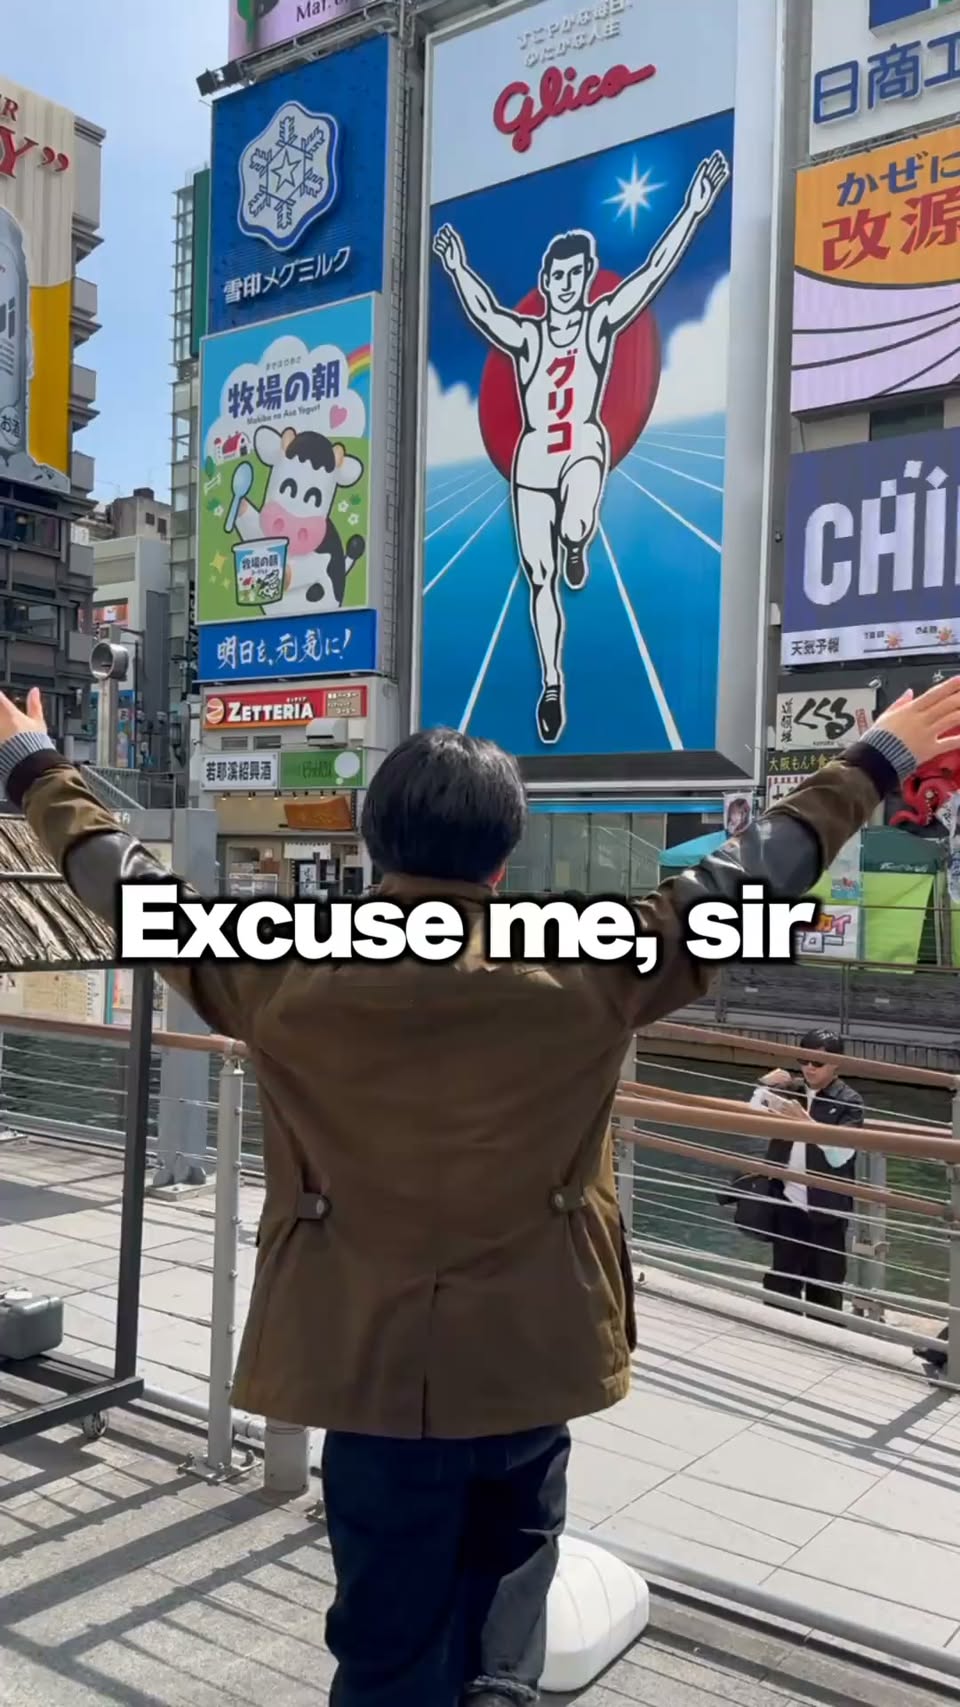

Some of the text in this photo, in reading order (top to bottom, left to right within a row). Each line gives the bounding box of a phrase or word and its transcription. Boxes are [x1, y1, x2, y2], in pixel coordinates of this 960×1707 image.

[493, 64, 656, 153] Glico
[837, 151, 960, 207] かぜに
[822, 185, 960, 271] 改源
[223, 247, 351, 304] 雪印メグミルク
[228, 359, 341, 419] 牧場の朝
[546, 348, 578, 454] グリコ
[227, 702, 314, 723] ZETTERIA
[793, 697, 855, 740] くくる
